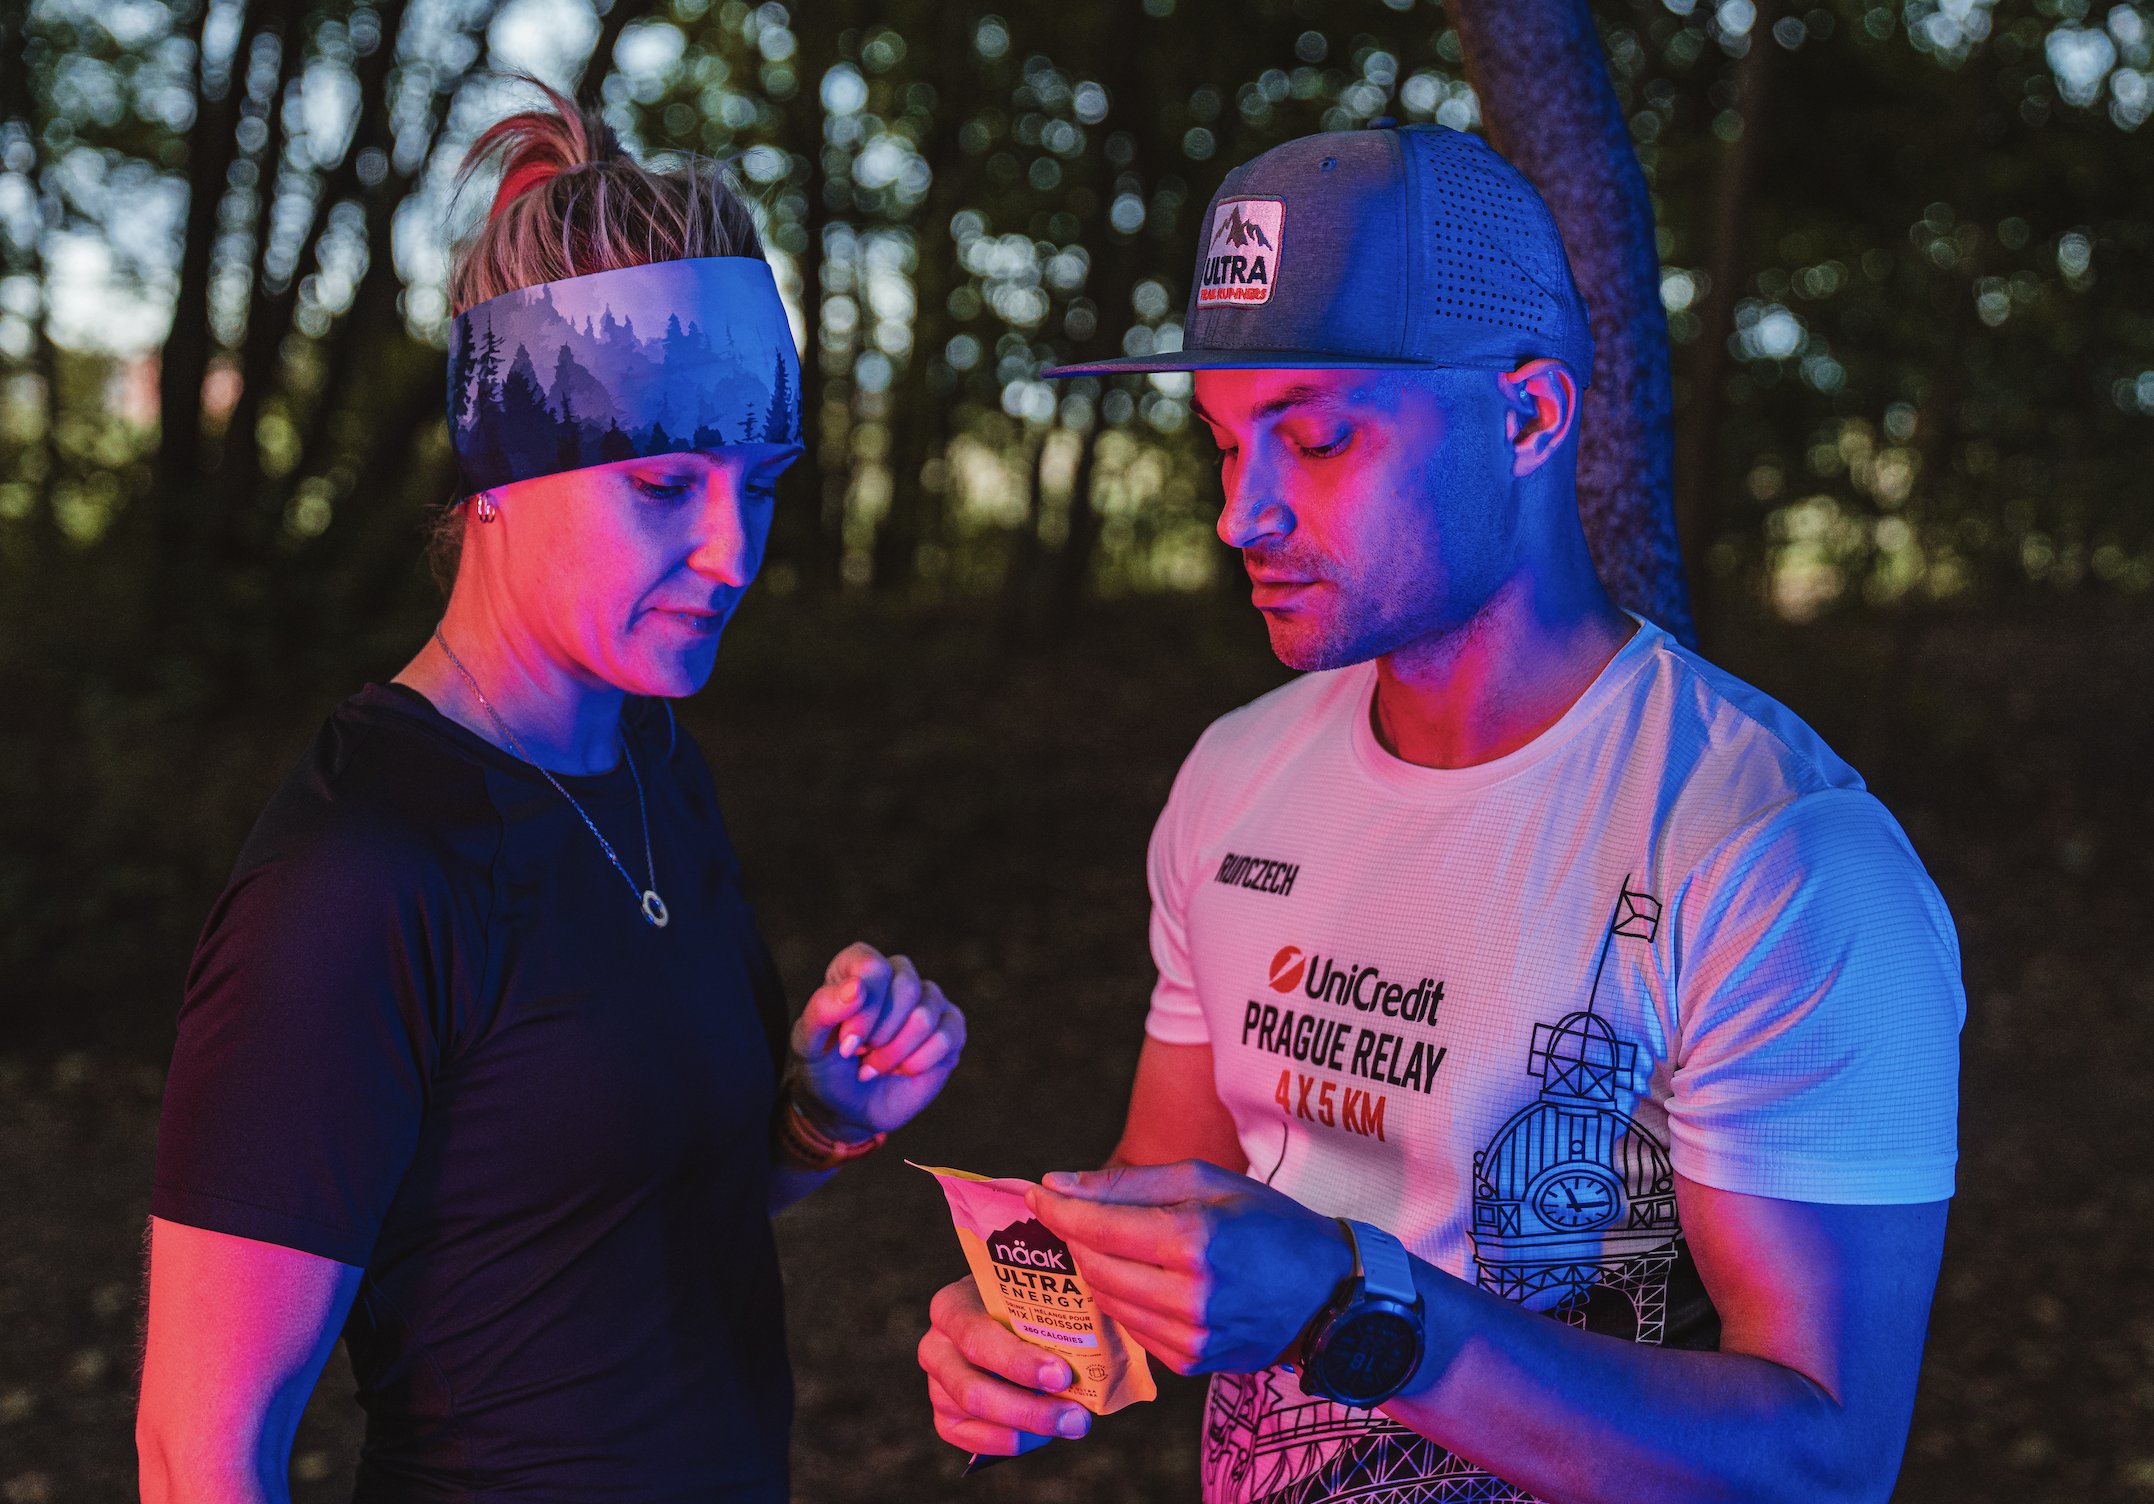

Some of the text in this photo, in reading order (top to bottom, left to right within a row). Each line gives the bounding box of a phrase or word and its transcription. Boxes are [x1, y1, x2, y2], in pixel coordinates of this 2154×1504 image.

[1203, 255, 1268, 286] ULTRA
[1217, 287, 1267, 300] RUNNERS
[1214, 852, 1300, 897] RUNCZECH
[1305, 955, 1445, 1027] UniCredit
[1241, 1000, 1447, 1095] PRAGUE RELAY
[1342, 1087, 1386, 1143] KM
[995, 1239, 1067, 1271] näak
[993, 1264, 1082, 1295] ULTRA
[1000, 1283, 1084, 1309] ENERGY
[1008, 1307, 1029, 1320] MIX
[1036, 1315, 1094, 1331] BOISSON
[1040, 1330, 1083, 1344] CALORIES
